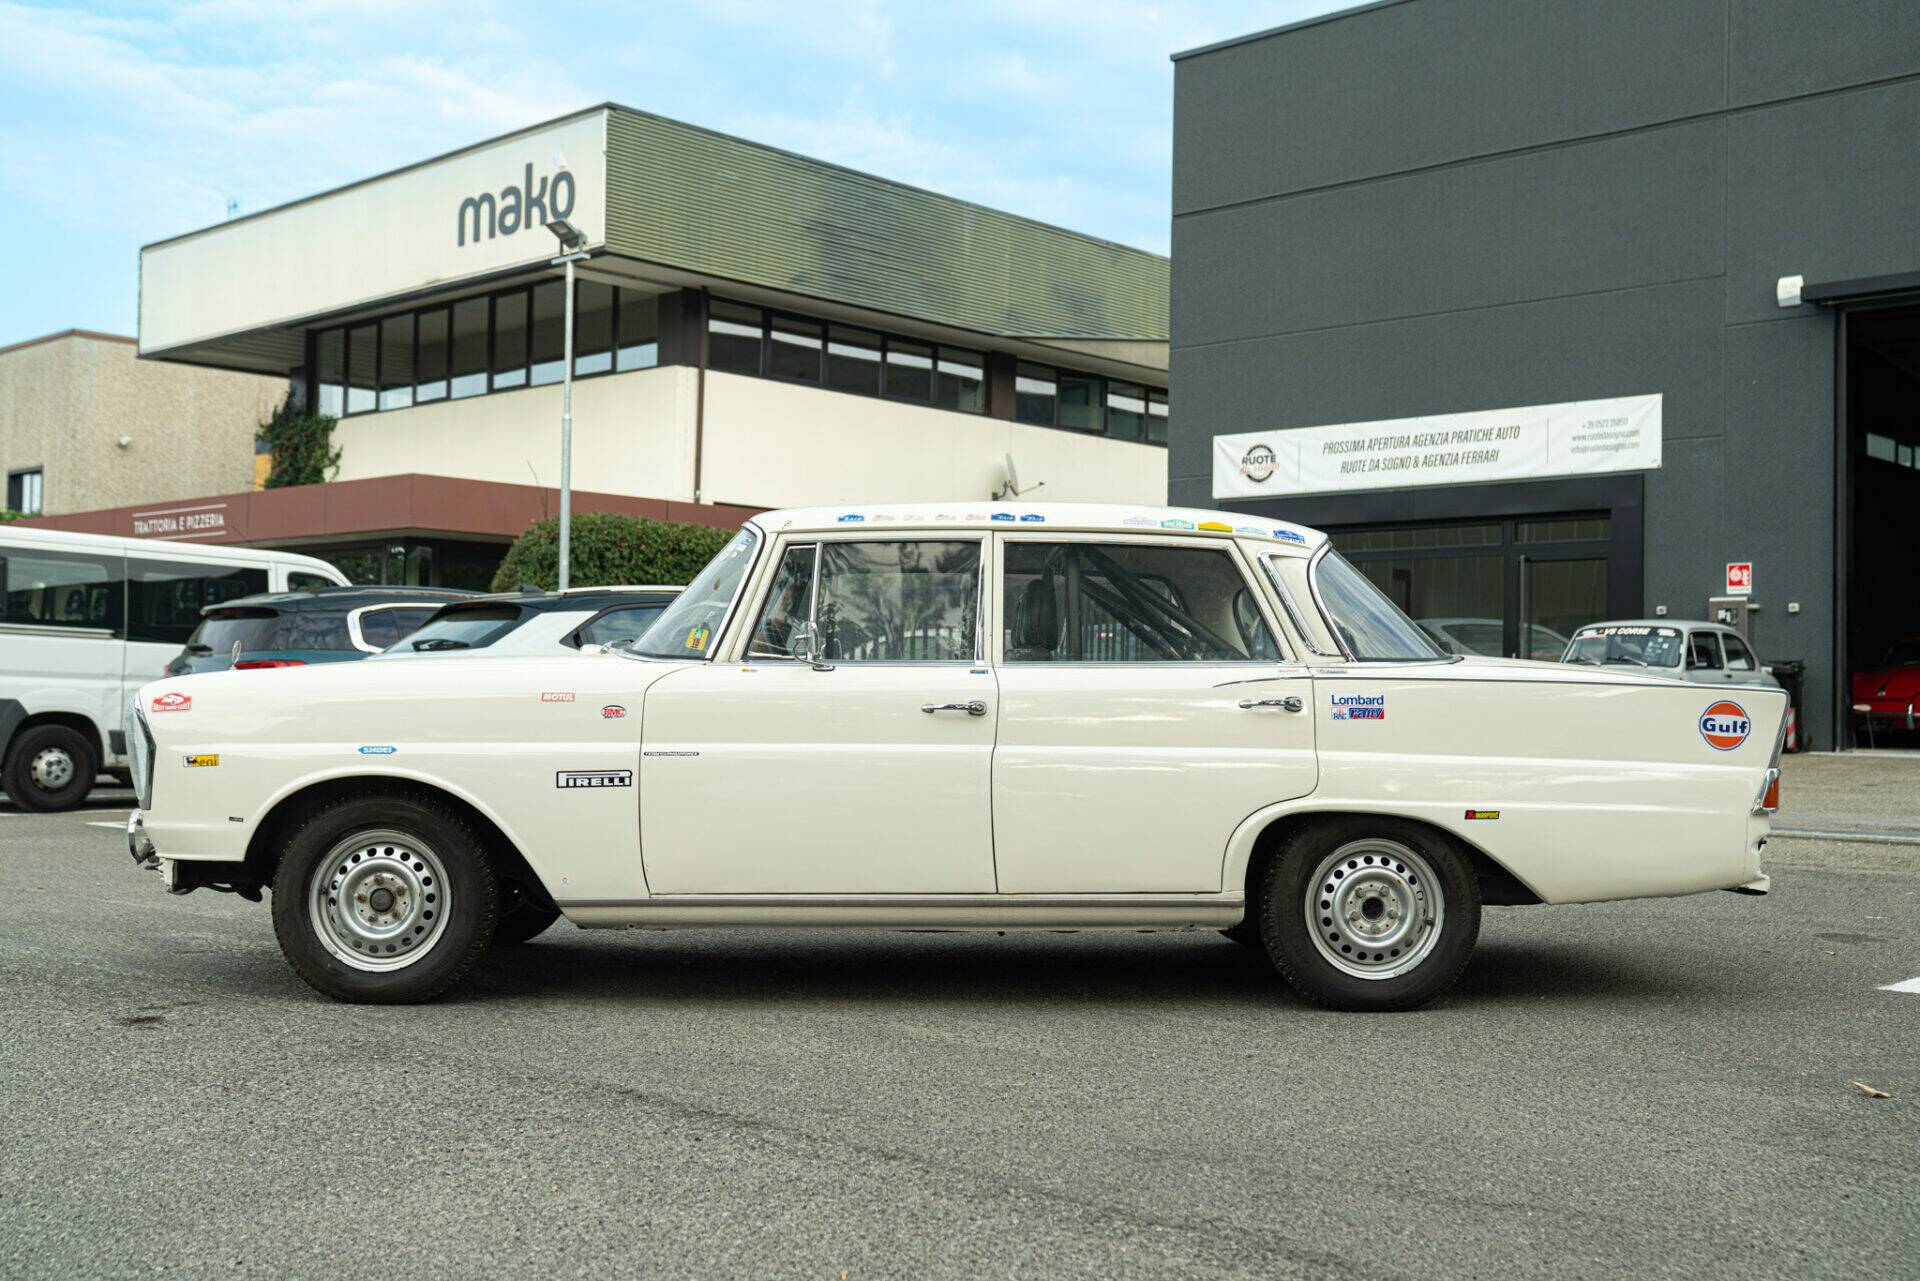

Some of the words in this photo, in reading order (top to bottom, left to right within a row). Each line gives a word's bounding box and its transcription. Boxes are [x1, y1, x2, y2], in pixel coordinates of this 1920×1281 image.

[458, 162, 576, 247] mako
[1322, 439, 1365, 455] PROSSIMA
[1366, 435, 1410, 452] APERTURA
[1411, 432, 1450, 448] AGENZIA
[1450, 427, 1494, 444] PRATICHE
[1495, 425, 1521, 441] AUTO
[1241, 454, 1277, 465] RUOTE
[1340, 459, 1368, 474] RUOTE
[1368, 458, 1380, 472] DA
[1381, 456, 1412, 471] SOGNO
[1412, 455, 1420, 468] &
[1421, 452, 1459, 468] AGENZIA
[1460, 448, 1500, 465] FERRARI
[133, 518, 178, 535] TRATTORIA
[178, 516, 185, 531] E
[186, 512, 225, 529] PIZZERIA
[542, 693, 574, 701] MOTUL
[1331, 694, 1384, 706] Lombard
[604, 708, 624, 716] BMC
[1702, 717, 1749, 734] Gulf
[200, 755, 218, 767] eni
[557, 770, 632, 788] PIRELLI
